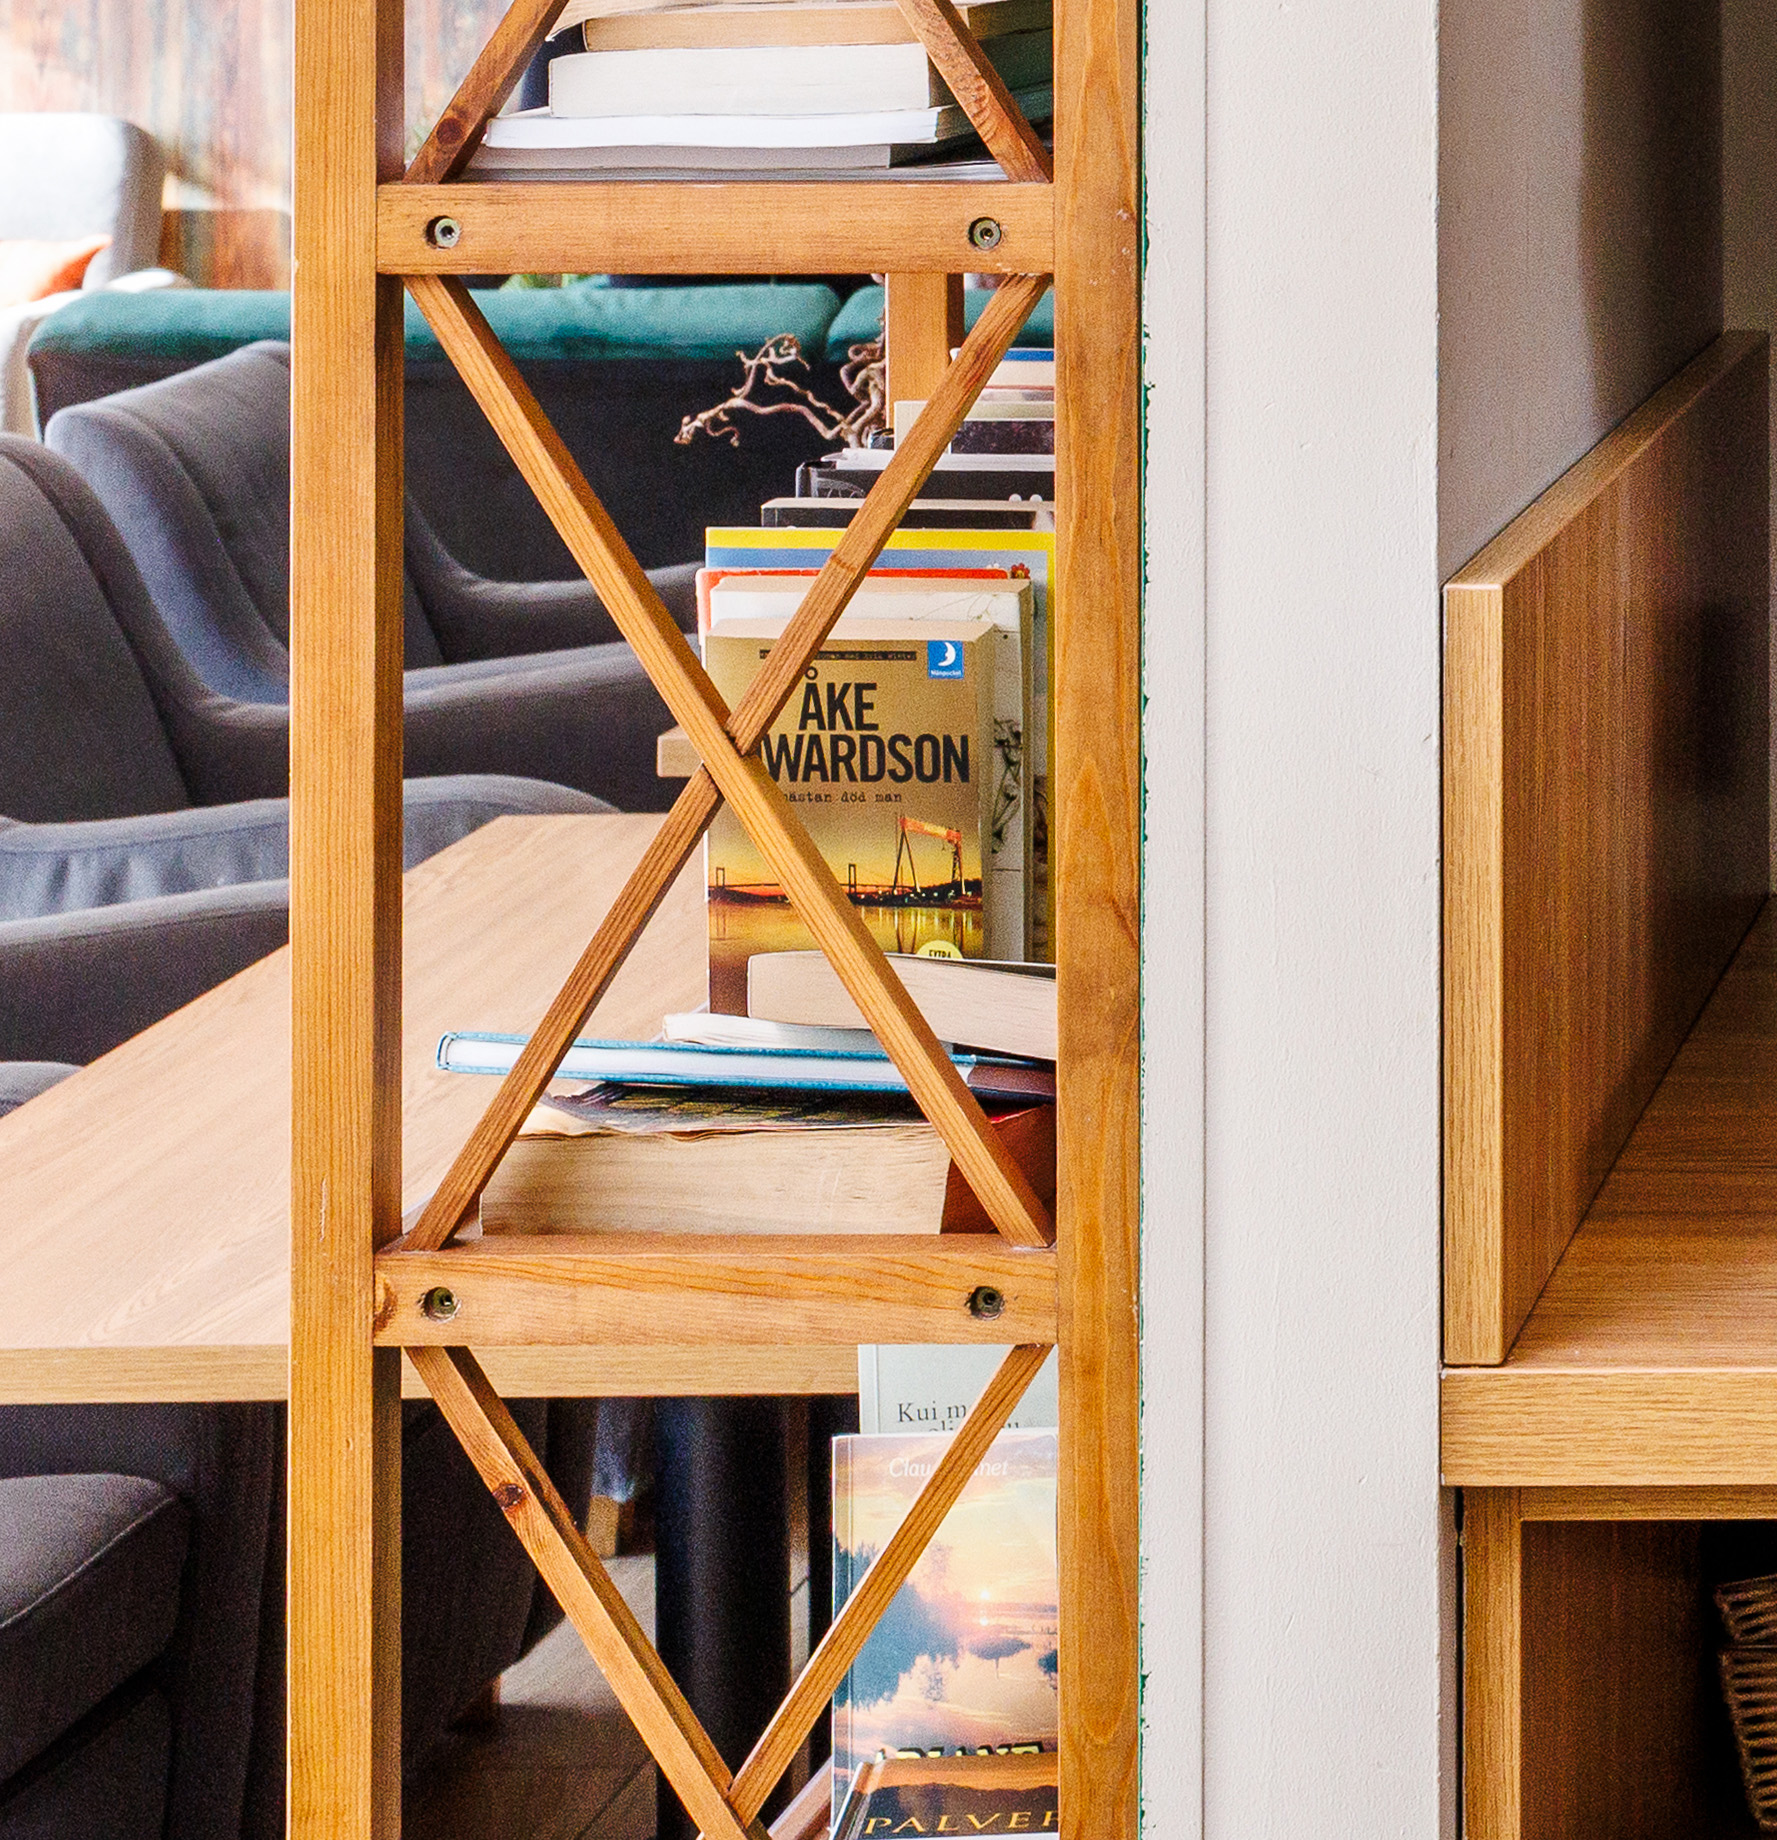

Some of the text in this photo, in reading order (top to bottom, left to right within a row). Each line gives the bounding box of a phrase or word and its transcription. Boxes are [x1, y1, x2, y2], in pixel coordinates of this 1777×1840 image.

[798, 666, 879, 731] ÅKE
[758, 733, 970, 783] WARDSON
[840, 790, 866, 803] död
[875, 792, 903, 803] man
[897, 1401, 938, 1423] Kui
[889, 1457, 932, 1478] Clau
